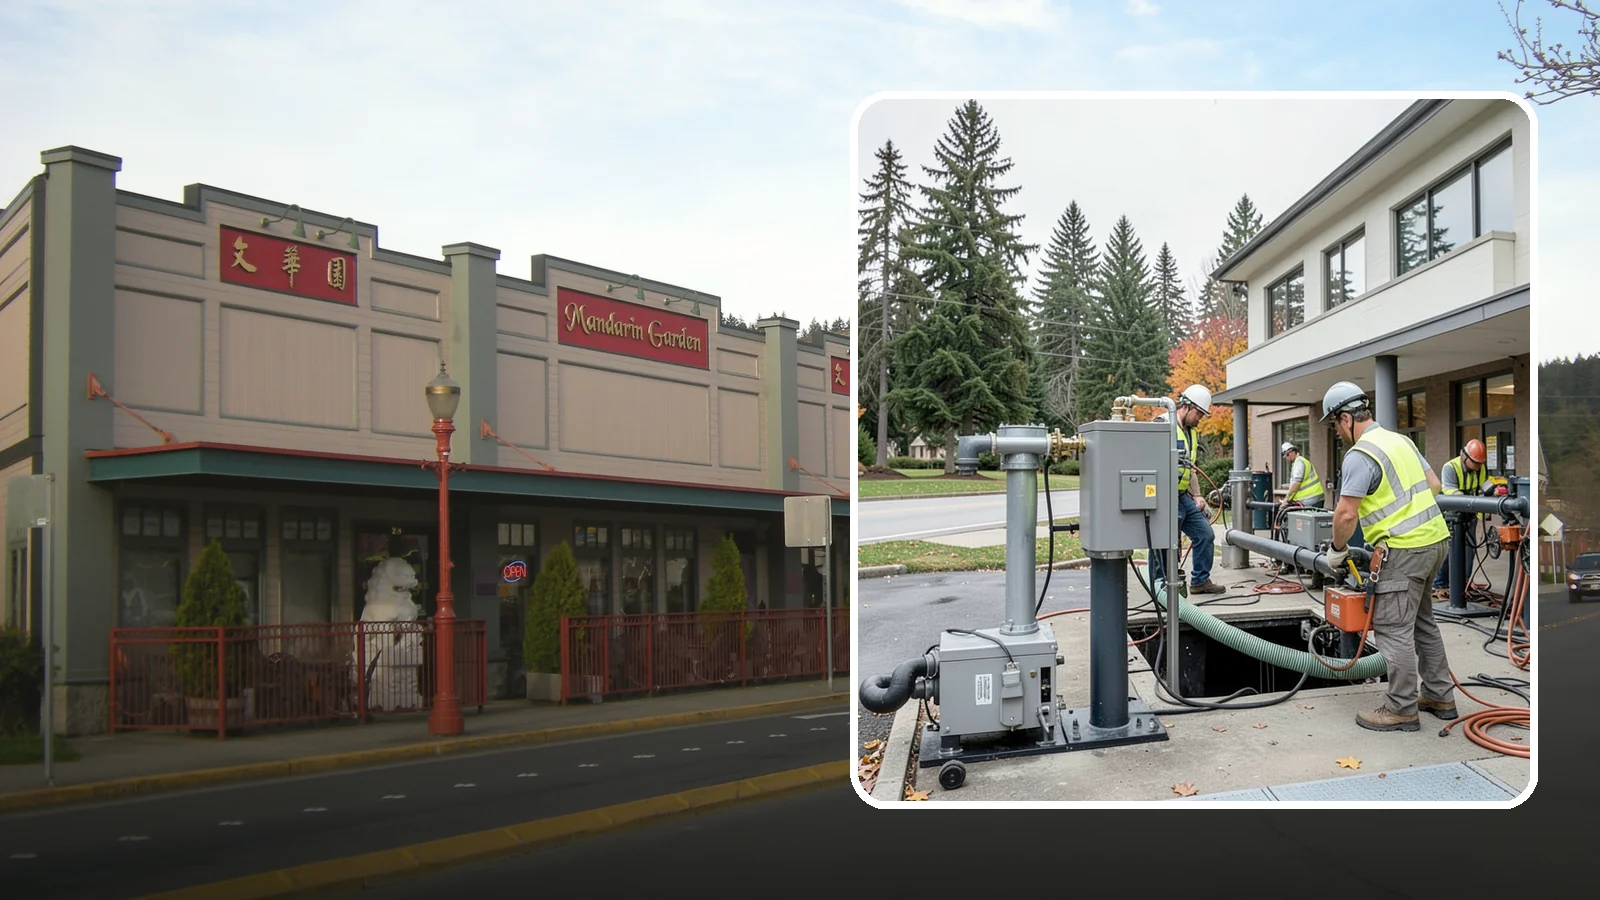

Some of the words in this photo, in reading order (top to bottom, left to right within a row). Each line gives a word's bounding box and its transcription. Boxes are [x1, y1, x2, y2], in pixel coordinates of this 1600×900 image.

[231, 235, 346, 290] 文華園
[564, 302, 644, 341] Mandarin
[648, 320, 702, 352] Garden
[503, 565, 527, 578] OPEN
